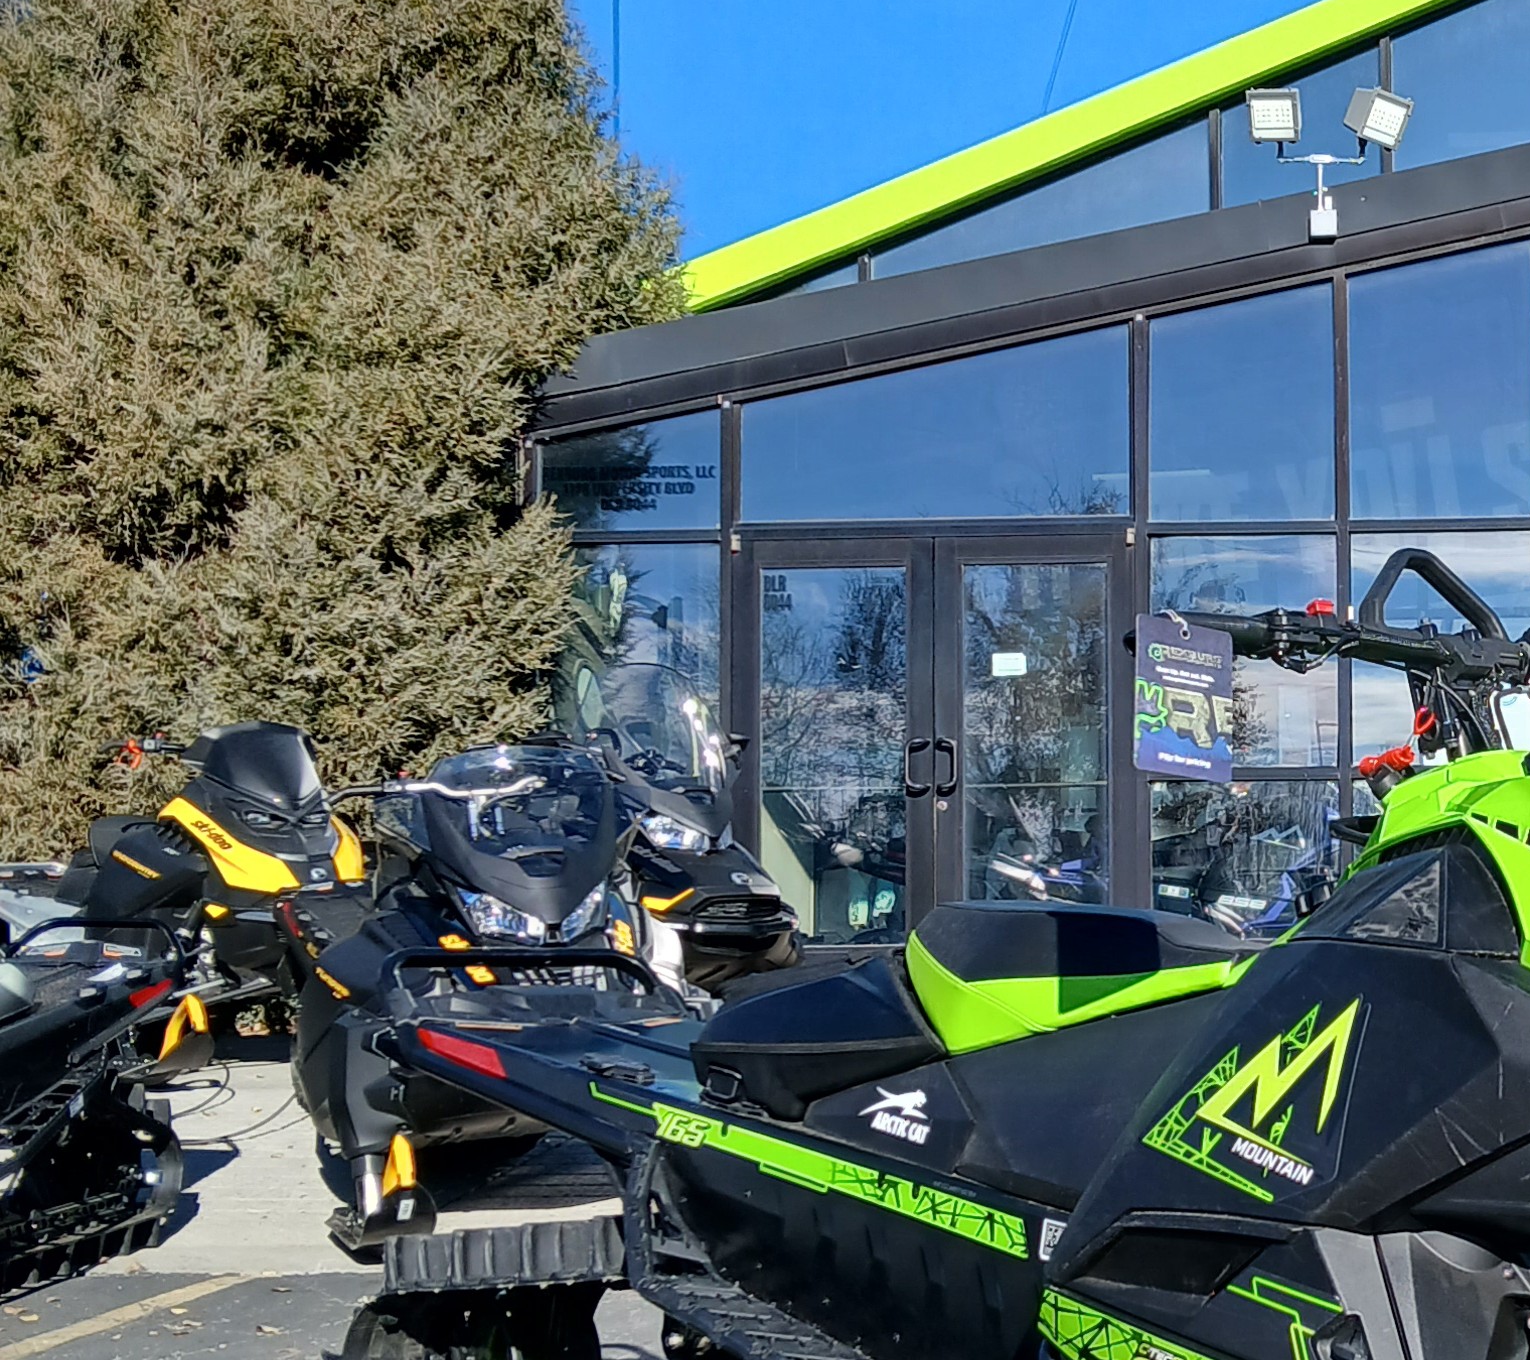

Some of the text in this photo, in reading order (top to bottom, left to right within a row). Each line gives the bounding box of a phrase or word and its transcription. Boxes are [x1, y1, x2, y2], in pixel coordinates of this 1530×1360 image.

[695, 465, 716, 479] LLC
[664, 481, 695, 495] BLVD
[763, 575, 787, 592] DLR
[656, 1111, 711, 1148] 165
[870, 1110, 931, 1145] ARCTIC CAT
[1230, 1137, 1315, 1186] MOUNTAIN
